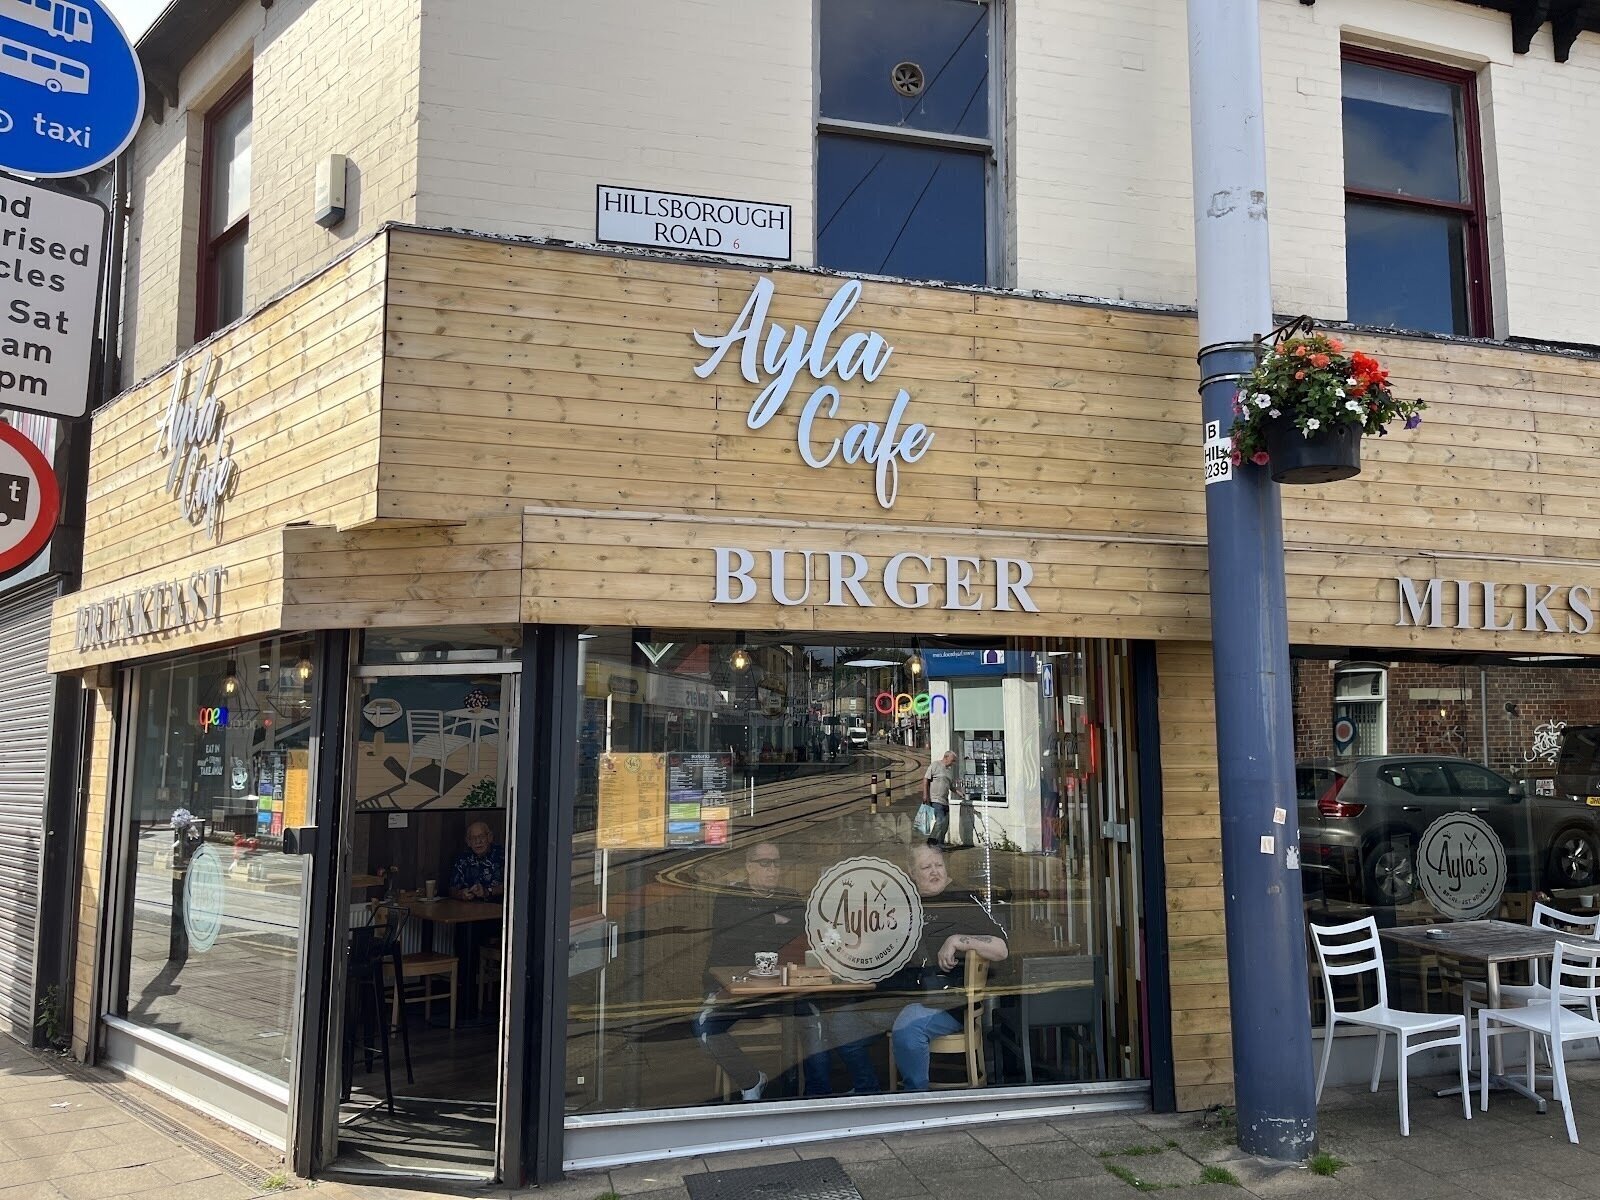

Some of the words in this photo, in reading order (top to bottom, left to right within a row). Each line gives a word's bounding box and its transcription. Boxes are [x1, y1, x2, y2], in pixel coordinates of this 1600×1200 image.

[33, 113, 91, 149] taxi
[604, 192, 785, 230] HILLSBOROUGH
[654, 222, 722, 248] ROAD
[733, 238, 740, 249] 6
[8, 299, 68, 334] Sat
[693, 276, 894, 429] Ayla
[798, 386, 935, 508] Cafe
[1208, 424, 1217, 439] B
[709, 547, 1041, 613] BURGER
[75, 565, 225, 650] BREAKFAST
[1394, 576, 1594, 635] MILKS
[199, 707, 229, 733] open
[875, 692, 947, 725] open
[1438, 840, 1488, 892] Ayla's
[832, 889, 898, 950] Ayla's
[874, 943, 895, 962] HOUSE
